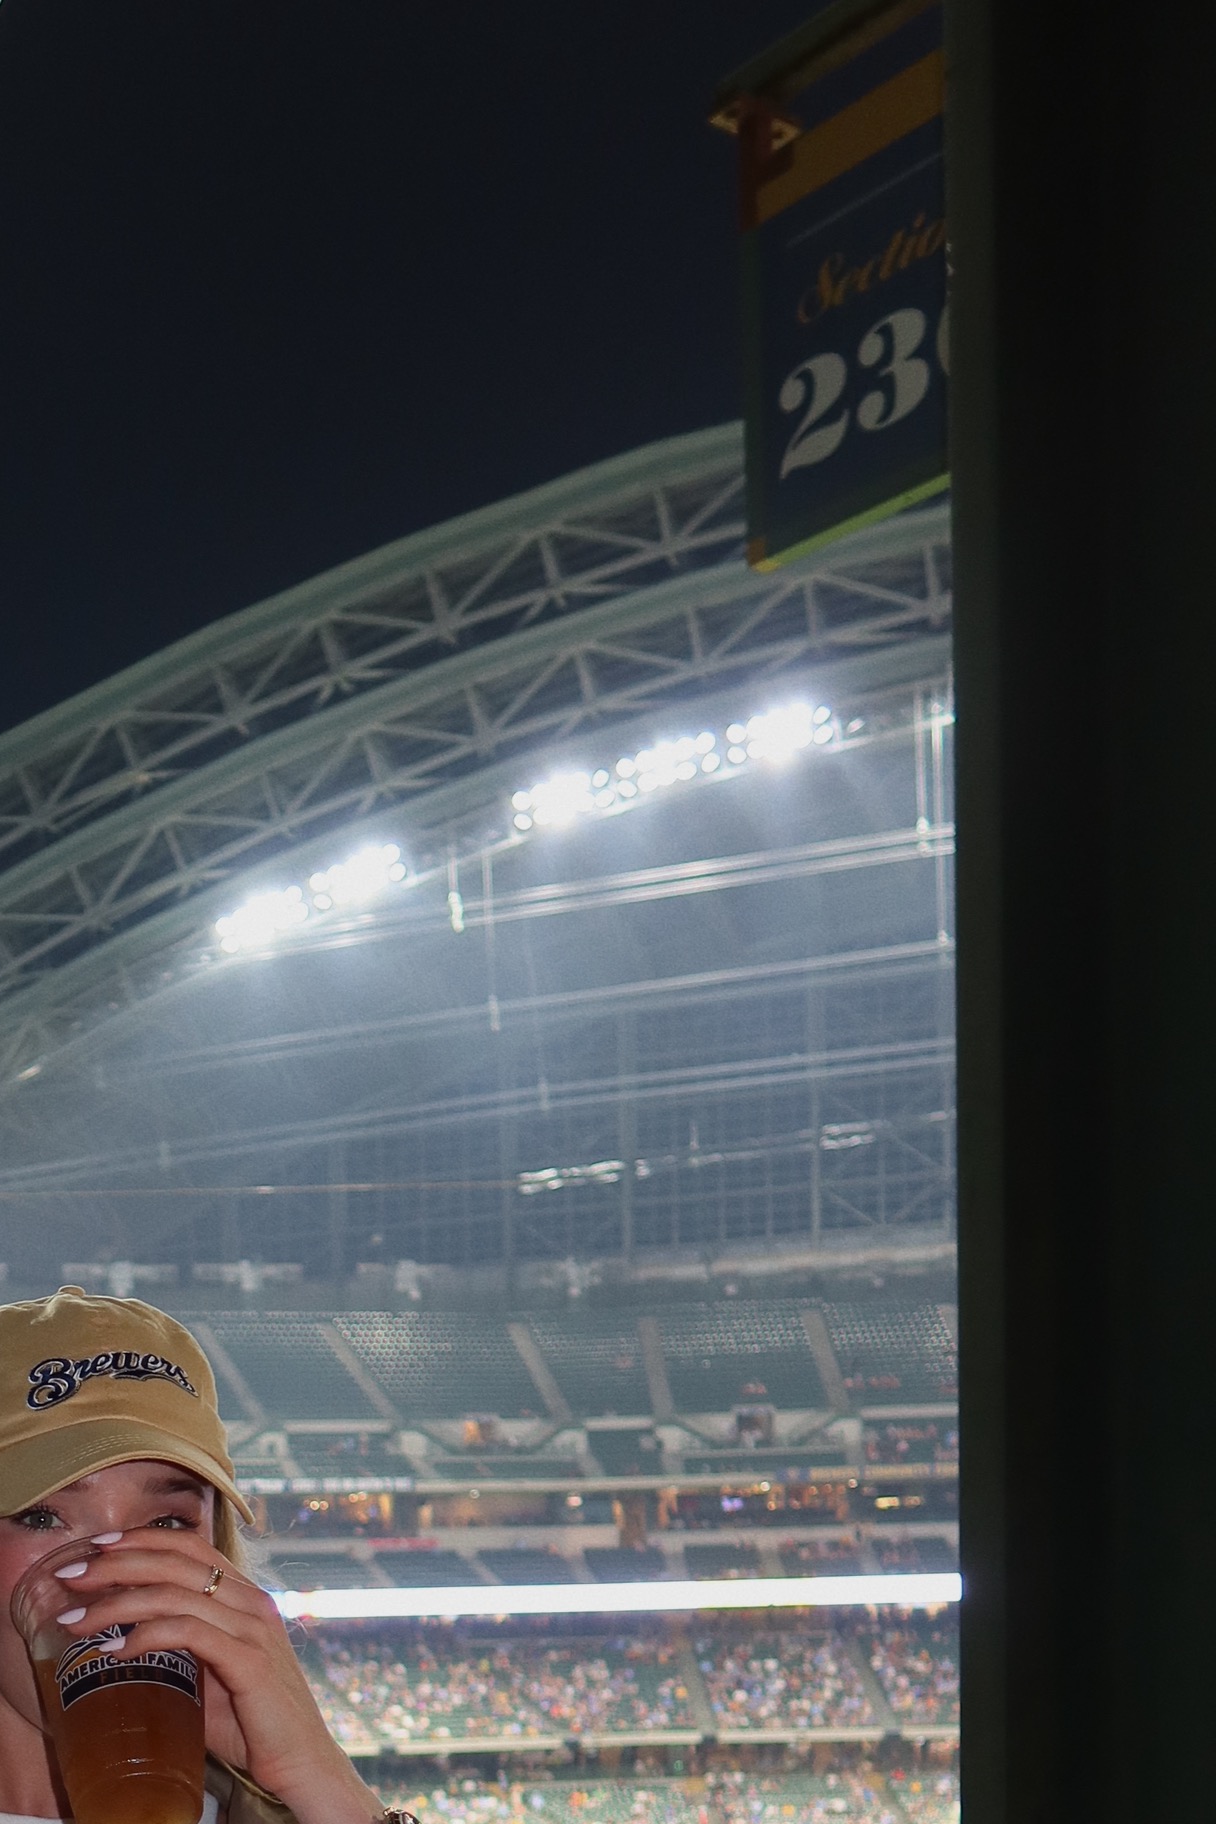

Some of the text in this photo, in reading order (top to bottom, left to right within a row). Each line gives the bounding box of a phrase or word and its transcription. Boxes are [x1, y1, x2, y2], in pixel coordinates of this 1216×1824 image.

[797, 211, 946, 325] Sectio
[27, 1351, 198, 1410] Brewers
[147, 1652, 196, 1682] FAMILY
